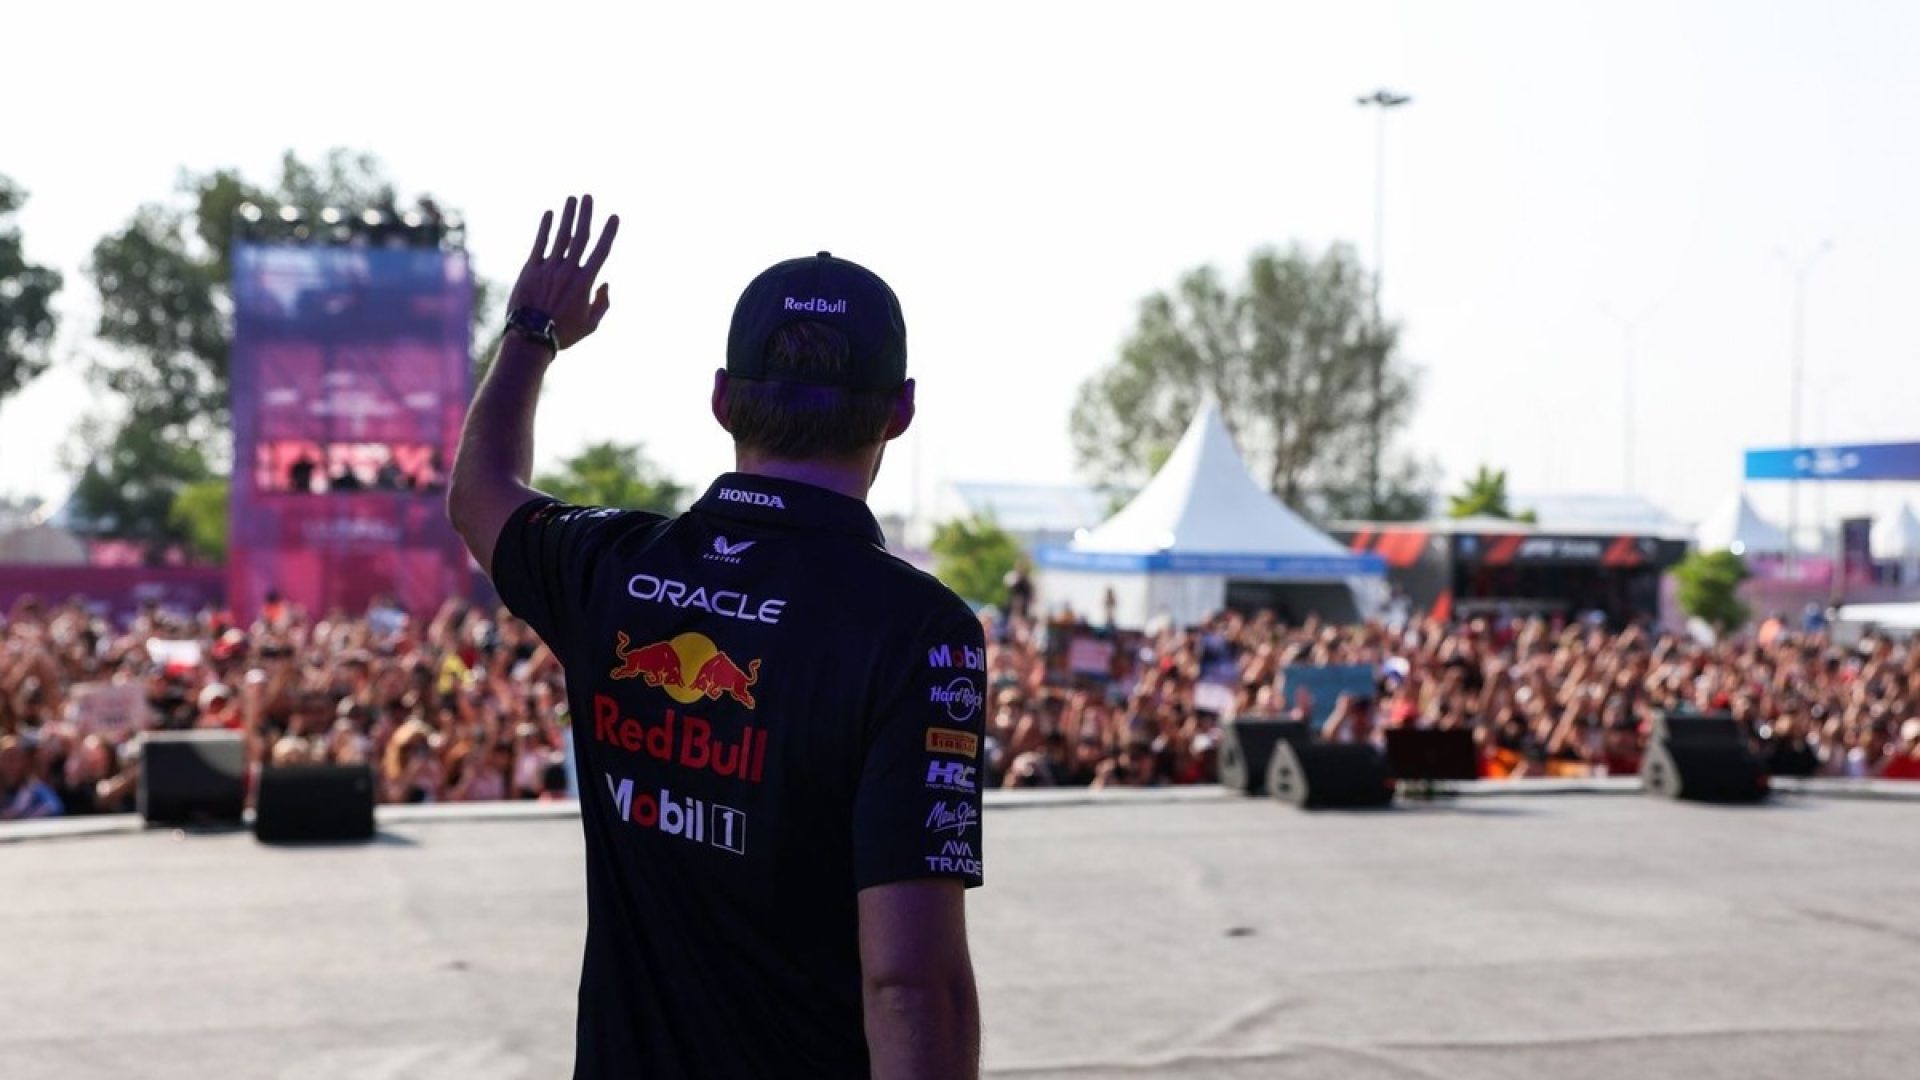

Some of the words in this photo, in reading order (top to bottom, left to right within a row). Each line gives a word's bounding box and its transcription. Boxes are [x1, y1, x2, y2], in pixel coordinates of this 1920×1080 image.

[784, 296, 814, 312] Red
[816, 298, 848, 313] Bull
[718, 487, 786, 510] HONDA
[627, 574, 787, 624] ORACLE
[927, 644, 985, 672] Mobil
[593, 692, 675, 761] Red
[679, 713, 768, 784] Bull
[926, 759, 977, 788] HRC
[605, 772, 705, 843] Mobil
[722, 809, 735, 848] 1
[941, 840, 973, 857] AVA
[925, 856, 982, 876] TRADE
